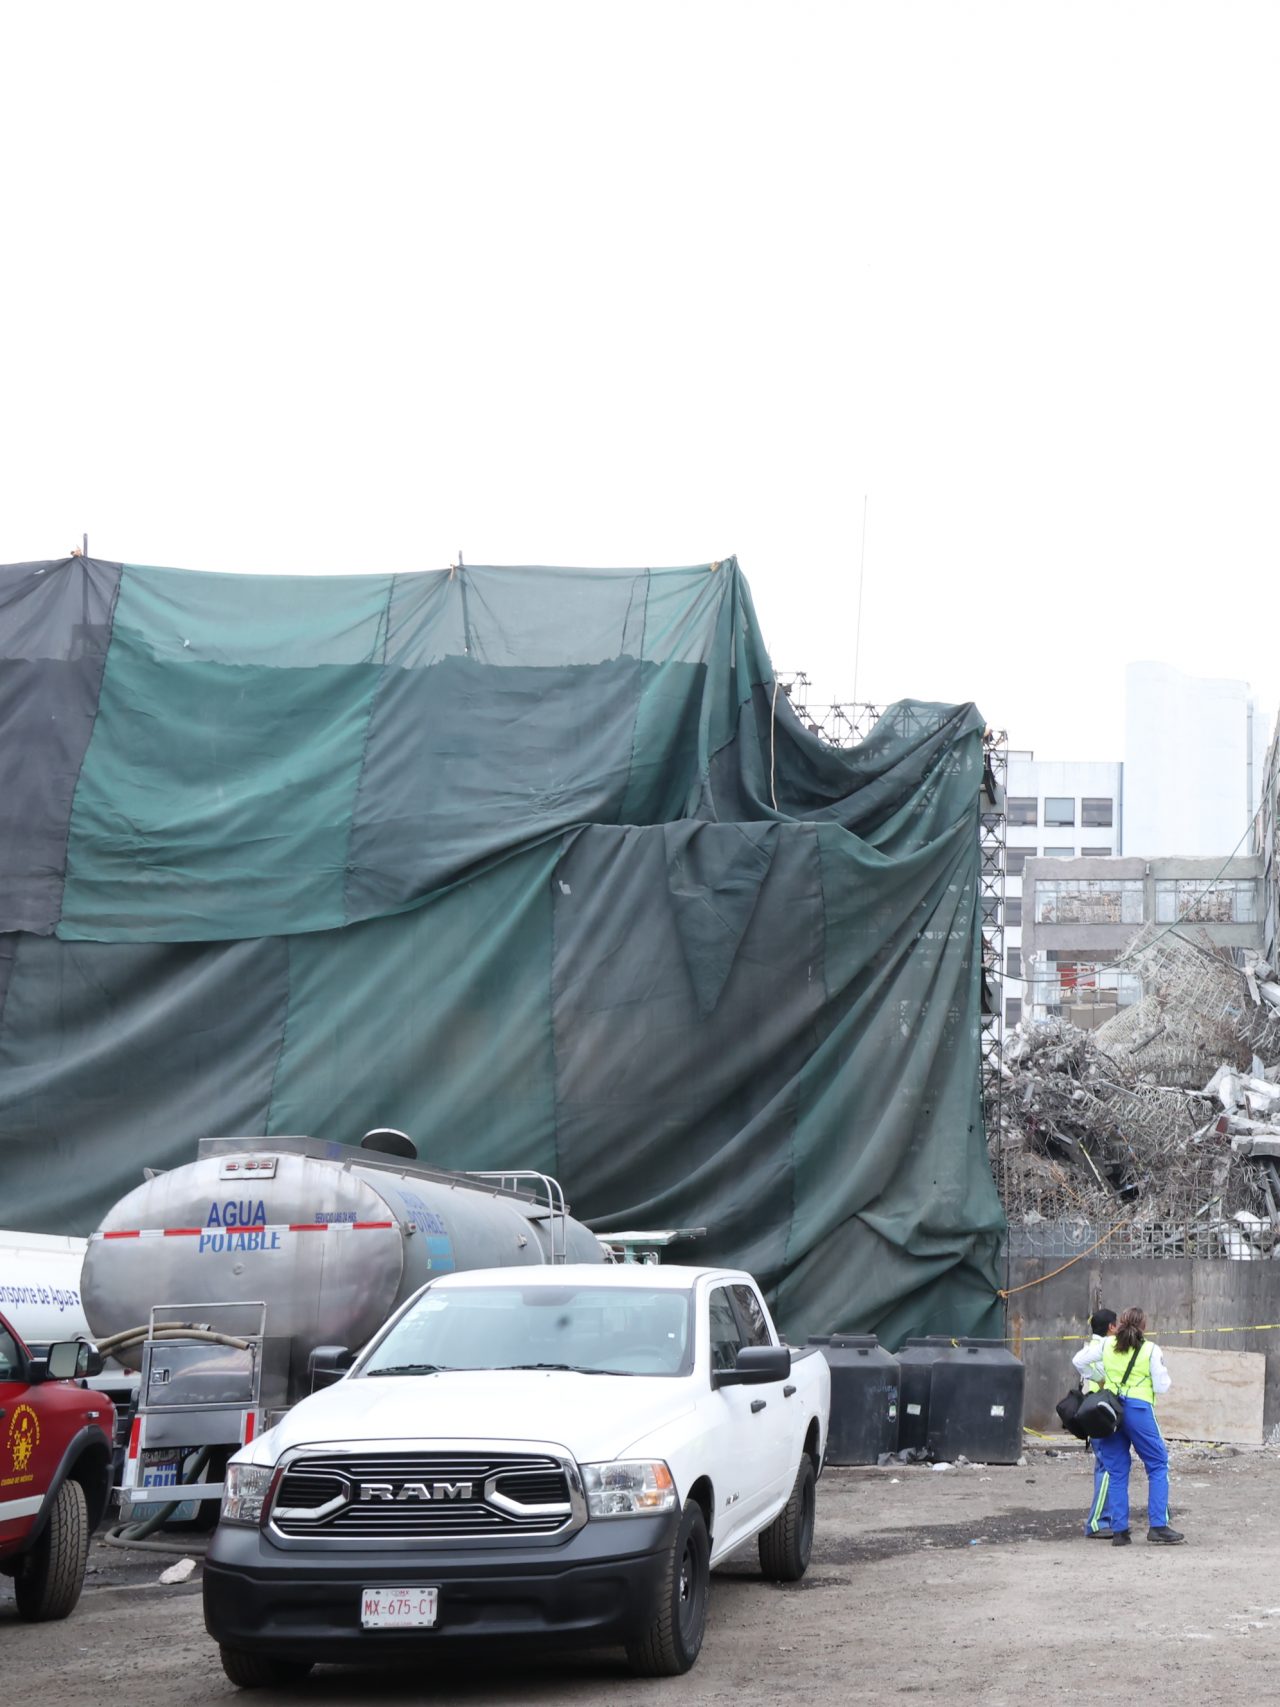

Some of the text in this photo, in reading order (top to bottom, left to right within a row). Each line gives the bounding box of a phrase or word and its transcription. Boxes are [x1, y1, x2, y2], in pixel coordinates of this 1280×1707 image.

[207, 1200, 267, 1227] AGUA
[199, 1231, 281, 1253] POTABLE
[37, 1282, 50, 1304] de
[49, 1284, 74, 1312] Agua
[360, 1482, 473, 1500] RAM
[365, 1599, 433, 1616] MX-675-C1
